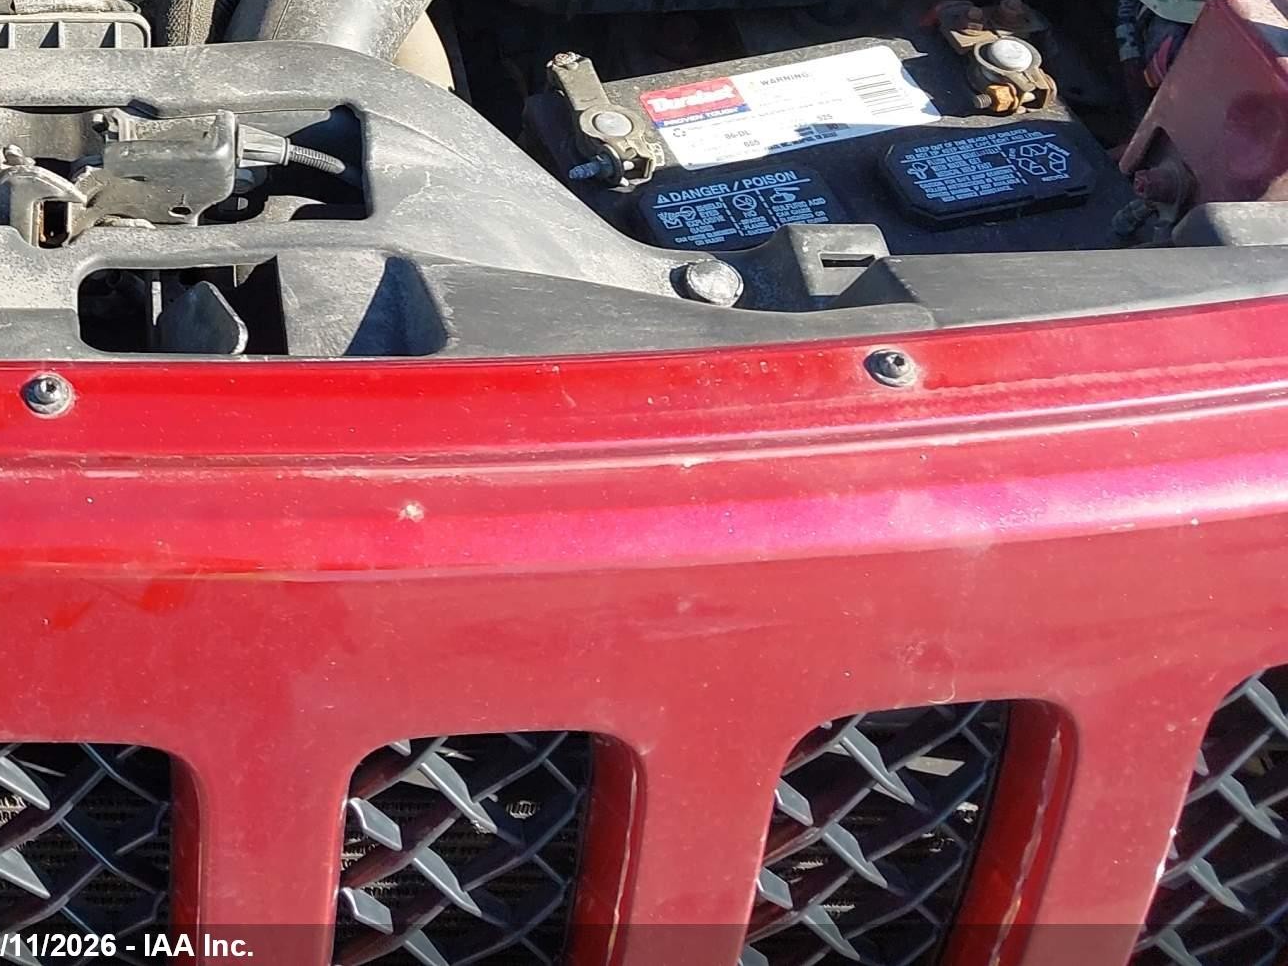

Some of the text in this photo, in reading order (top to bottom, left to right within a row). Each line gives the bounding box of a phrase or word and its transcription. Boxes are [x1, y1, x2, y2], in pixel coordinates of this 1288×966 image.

[760, 73, 809, 86] WARNING
[668, 169, 799, 203] DANGER / POISON
